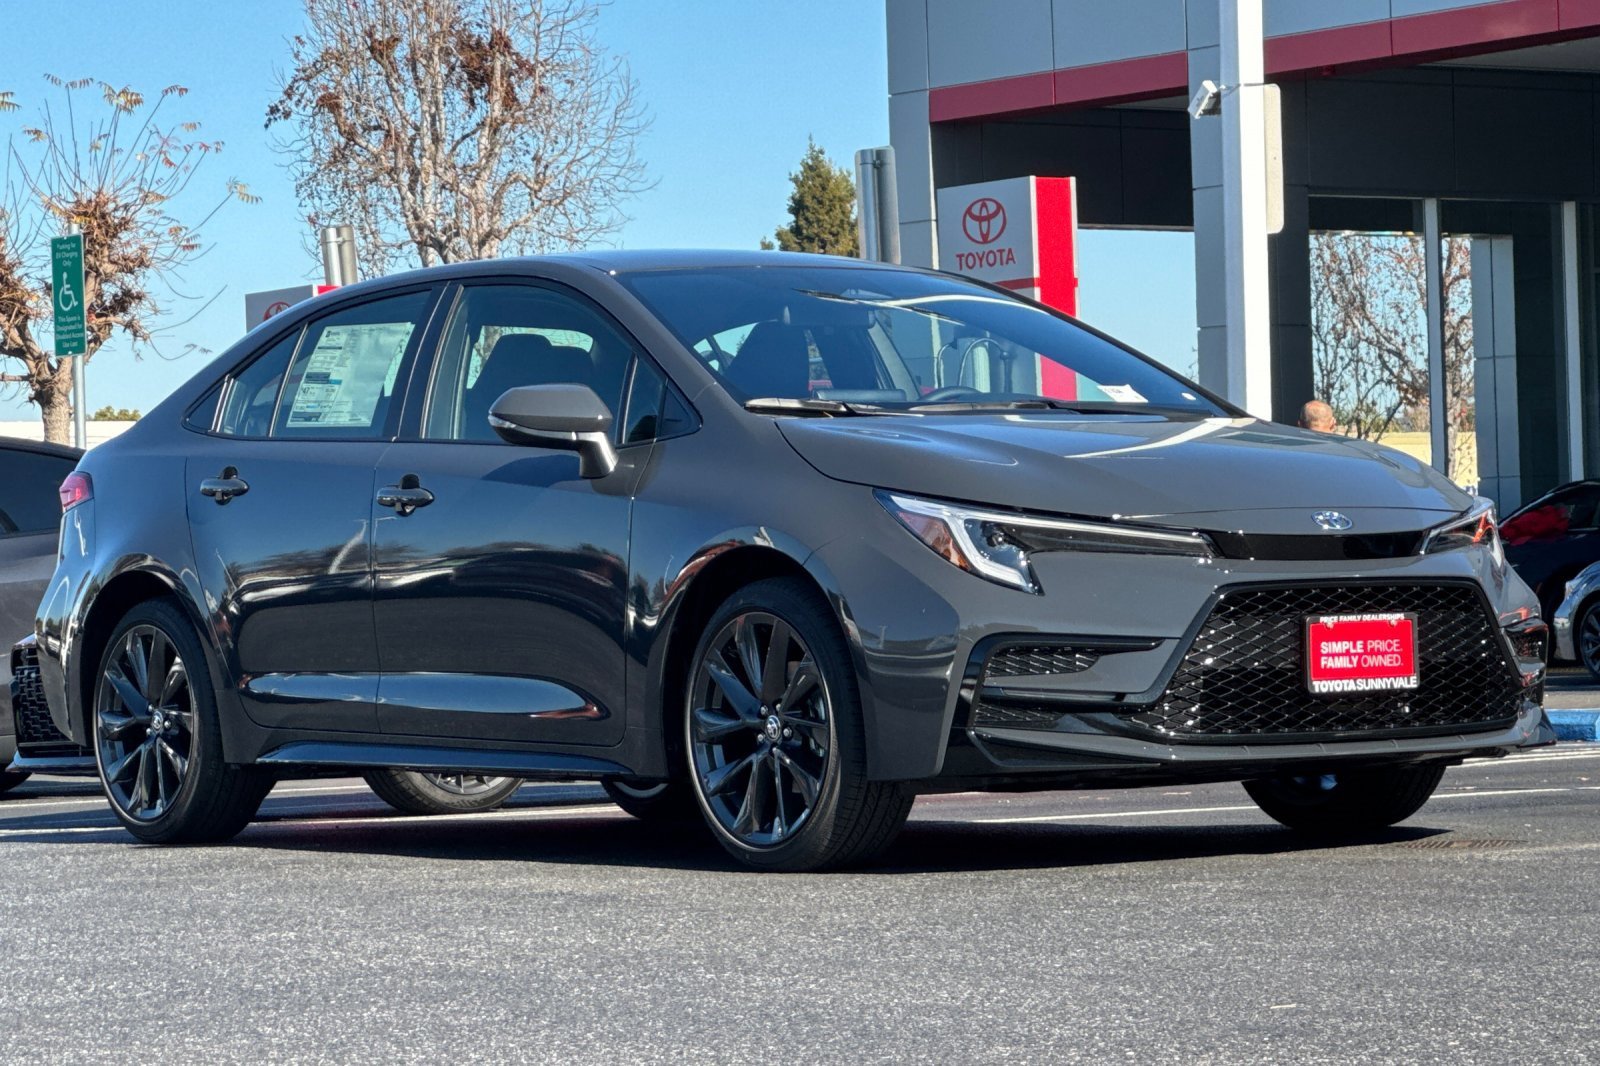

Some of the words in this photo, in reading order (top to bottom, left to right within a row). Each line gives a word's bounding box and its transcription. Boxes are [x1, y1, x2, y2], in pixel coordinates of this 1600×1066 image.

[956, 248, 1016, 271] TOYOTA
[1362, 613, 1405, 621] DEALERSHIPS
[1320, 641, 1364, 654] SIMPLE
[1367, 639, 1403, 653] PRICE.
[1320, 655, 1359, 669] FAMILY
[1361, 654, 1403, 667] OWNED.
